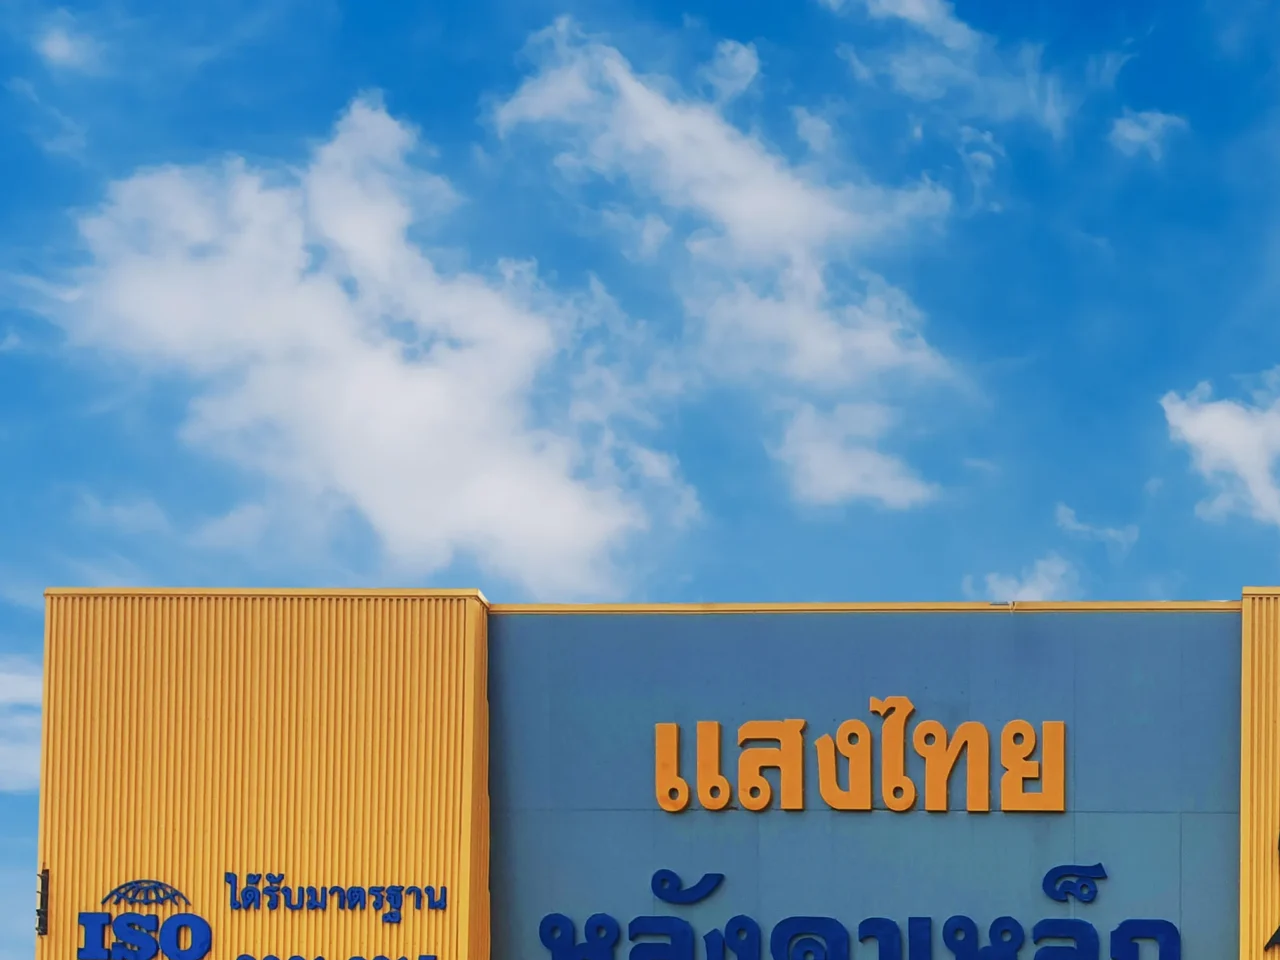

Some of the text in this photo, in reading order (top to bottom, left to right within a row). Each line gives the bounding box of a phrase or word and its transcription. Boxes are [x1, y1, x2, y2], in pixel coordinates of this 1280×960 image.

[653, 695, 1067, 814] แสงไทย
[224, 872, 447, 923] ได้รับมาตรฐาน
